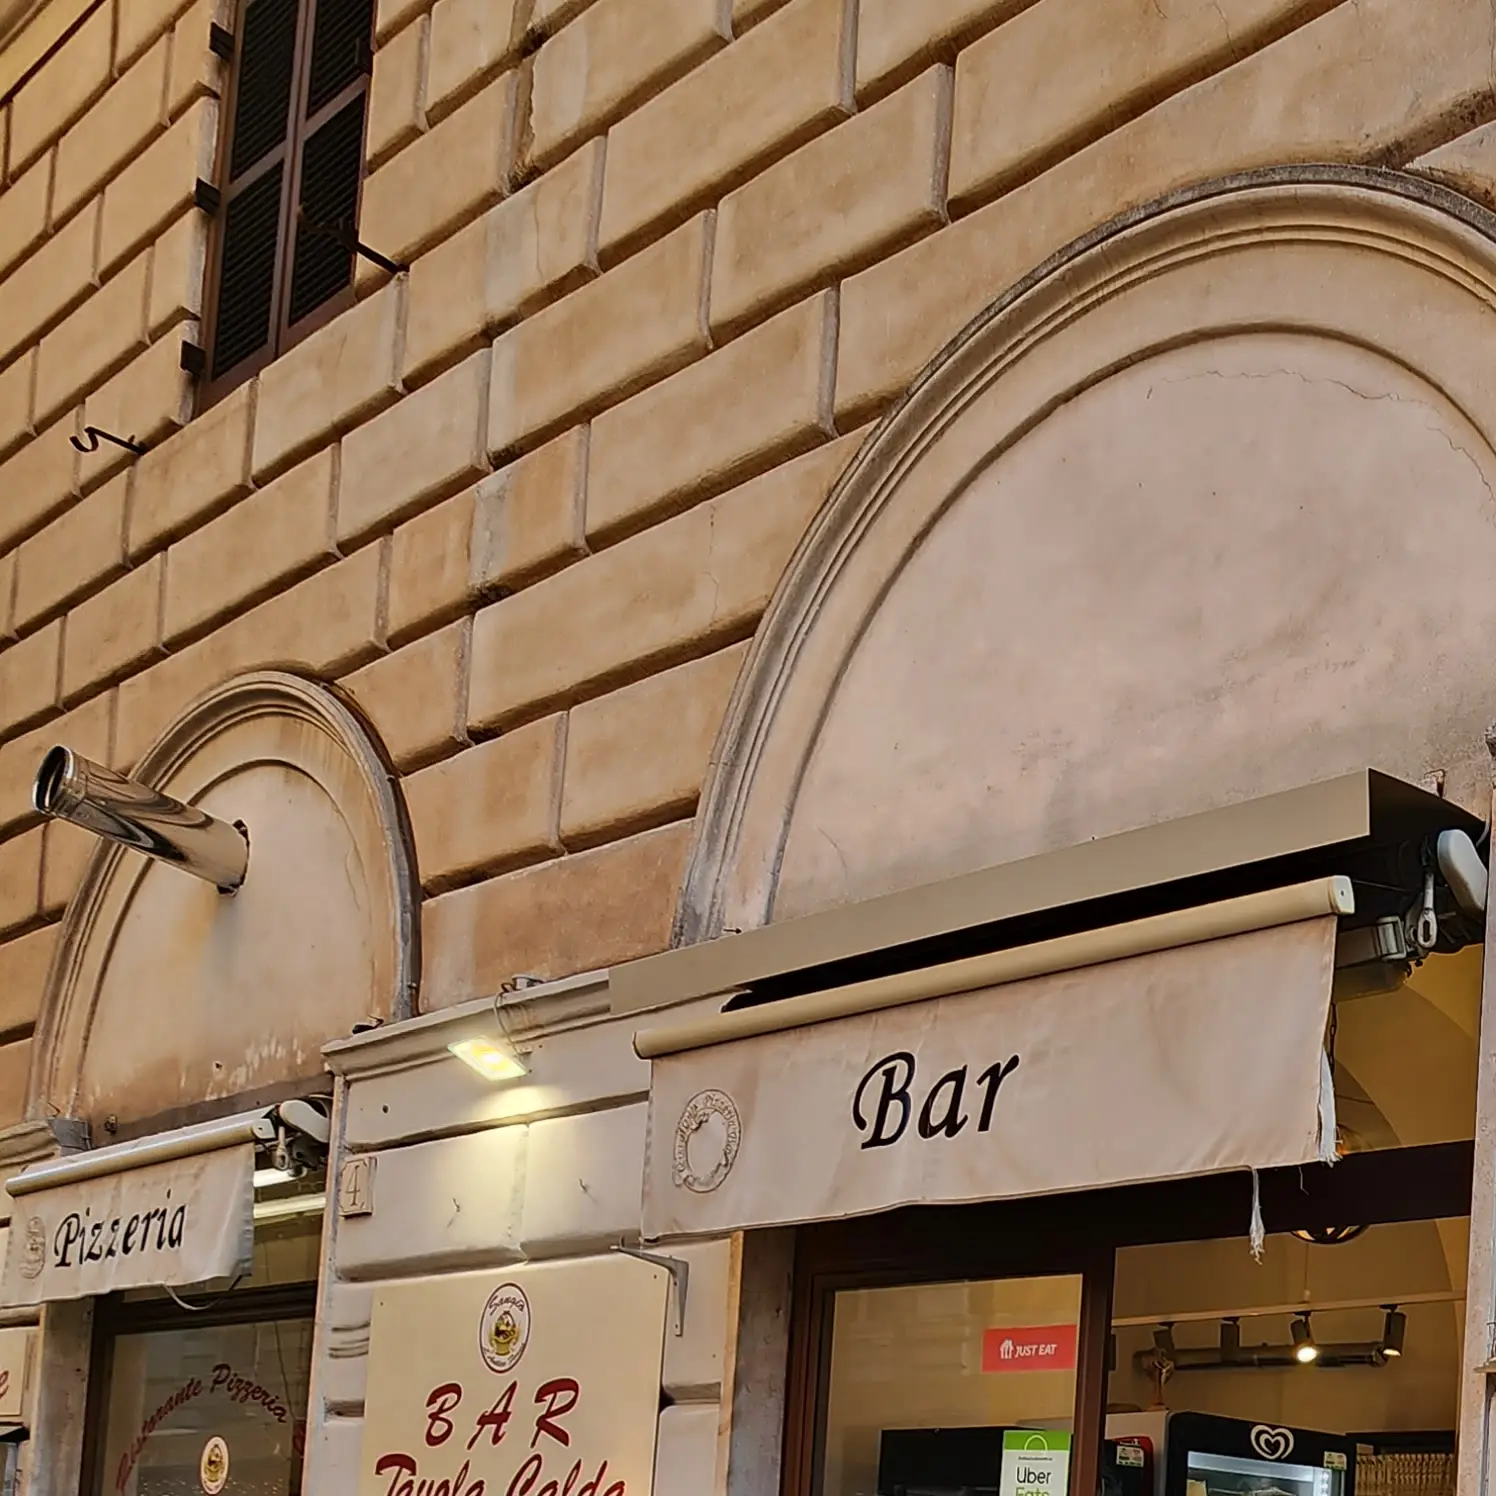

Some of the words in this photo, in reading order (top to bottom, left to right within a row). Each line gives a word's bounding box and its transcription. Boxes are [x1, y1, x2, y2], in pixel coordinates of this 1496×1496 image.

[852, 1051, 1020, 1150] Bar
[345, 1165, 360, 1206] 4
[54, 1189, 187, 1267] Pizzeria
[1014, 1345, 1038, 1358] JUST
[1038, 1343, 1057, 1355] EAT
[210, 1363, 288, 1424] Pizzeria
[425, 1378, 580, 1450] BAR
[1016, 1467, 1052, 1485] Uber
